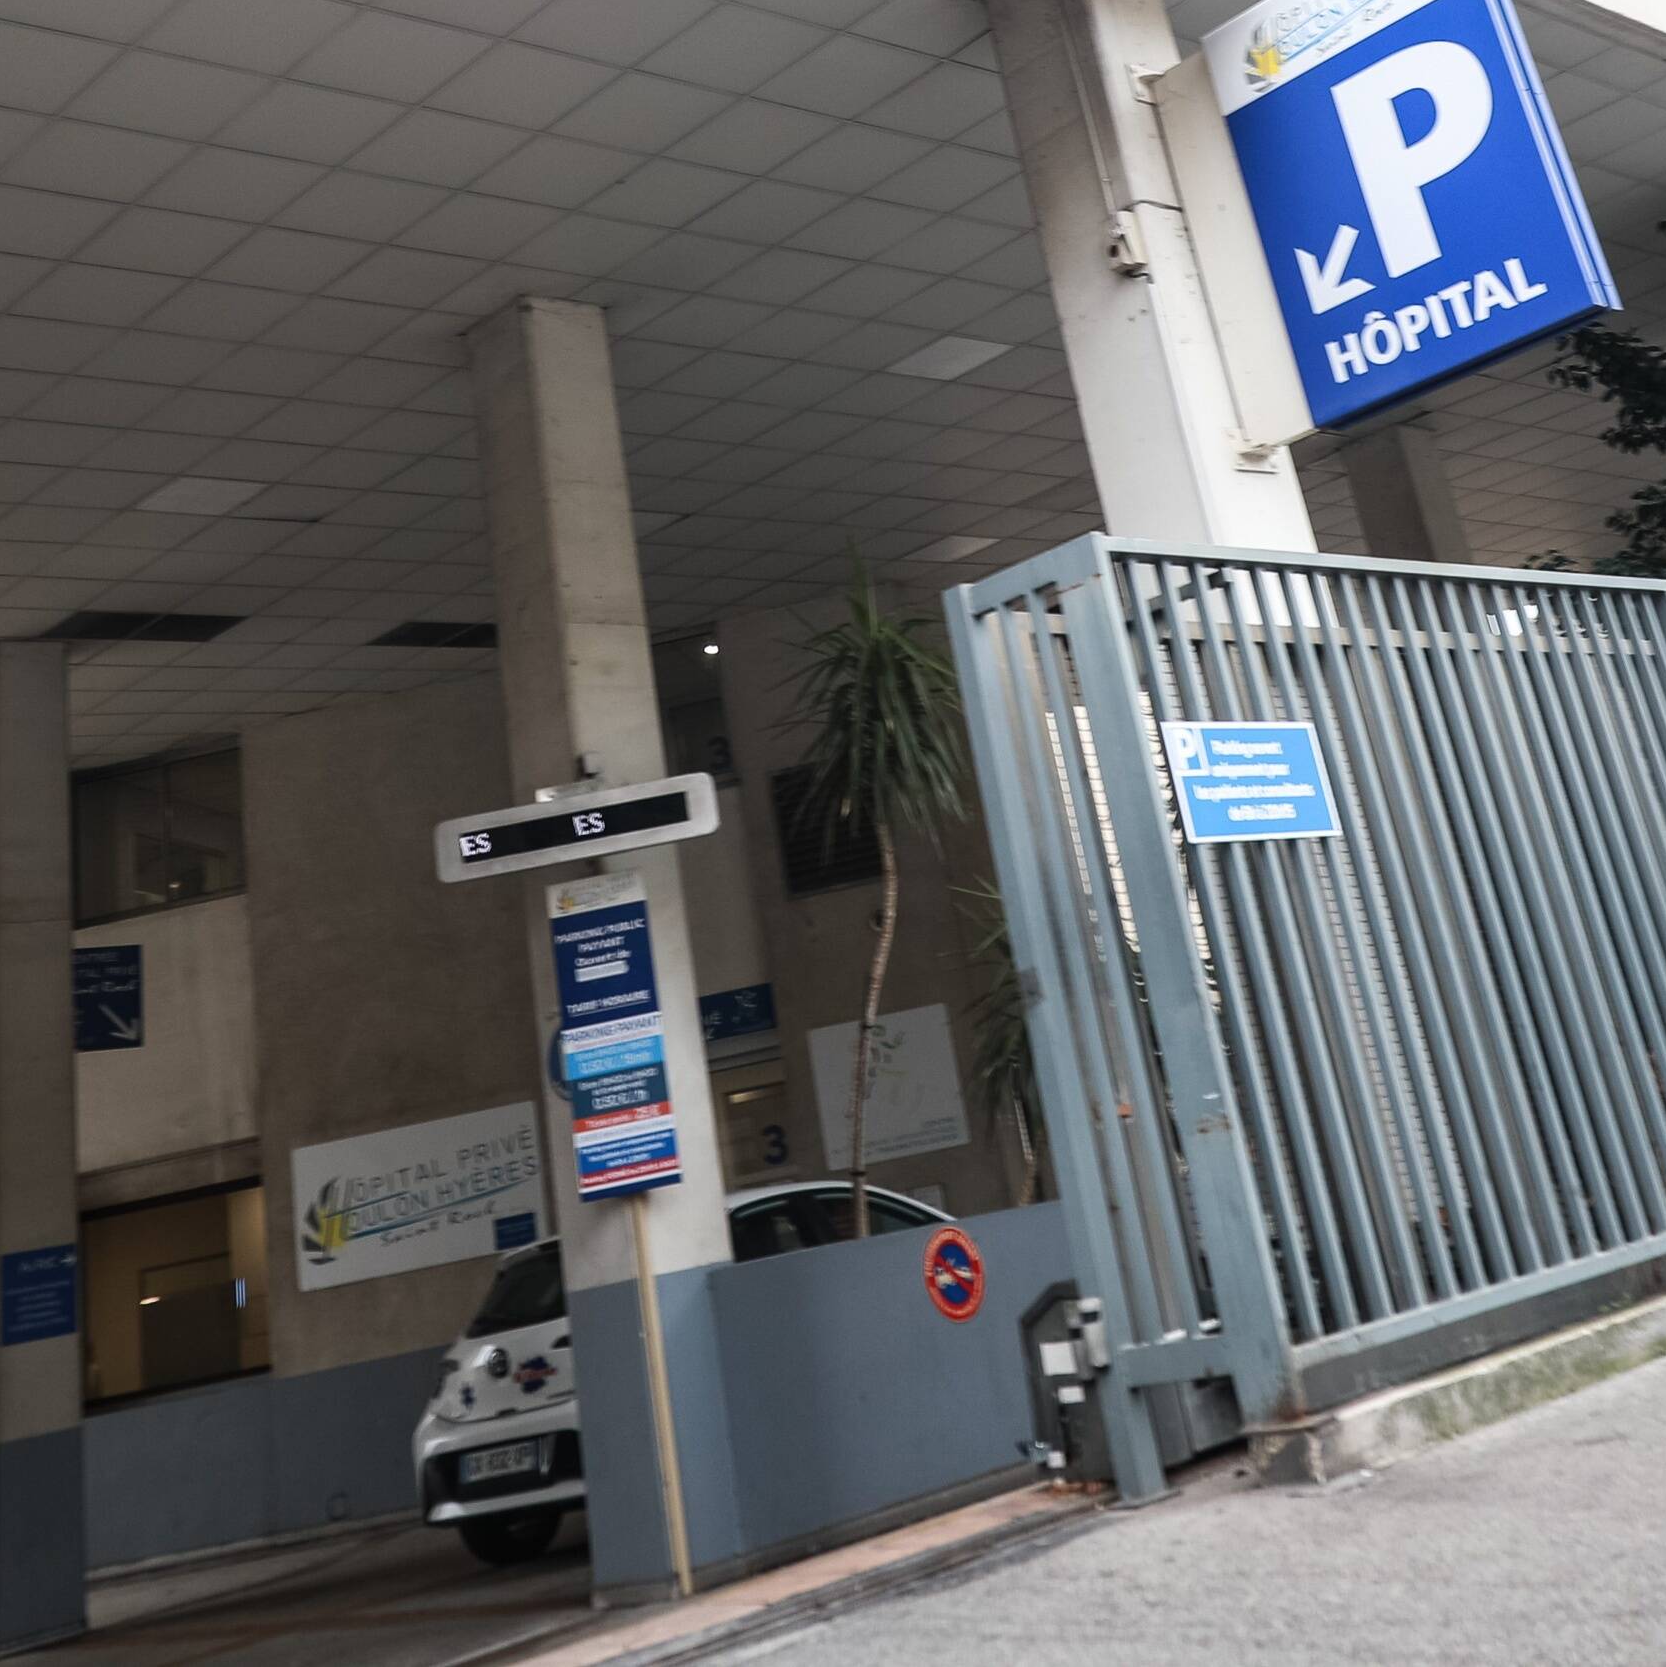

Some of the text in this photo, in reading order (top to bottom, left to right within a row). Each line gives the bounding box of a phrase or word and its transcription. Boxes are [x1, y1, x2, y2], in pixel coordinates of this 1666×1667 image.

[1332, 40, 1493, 279] P
[1324, 256, 1549, 384] HÔPITAL
[762, 1123, 789, 1165] 3
